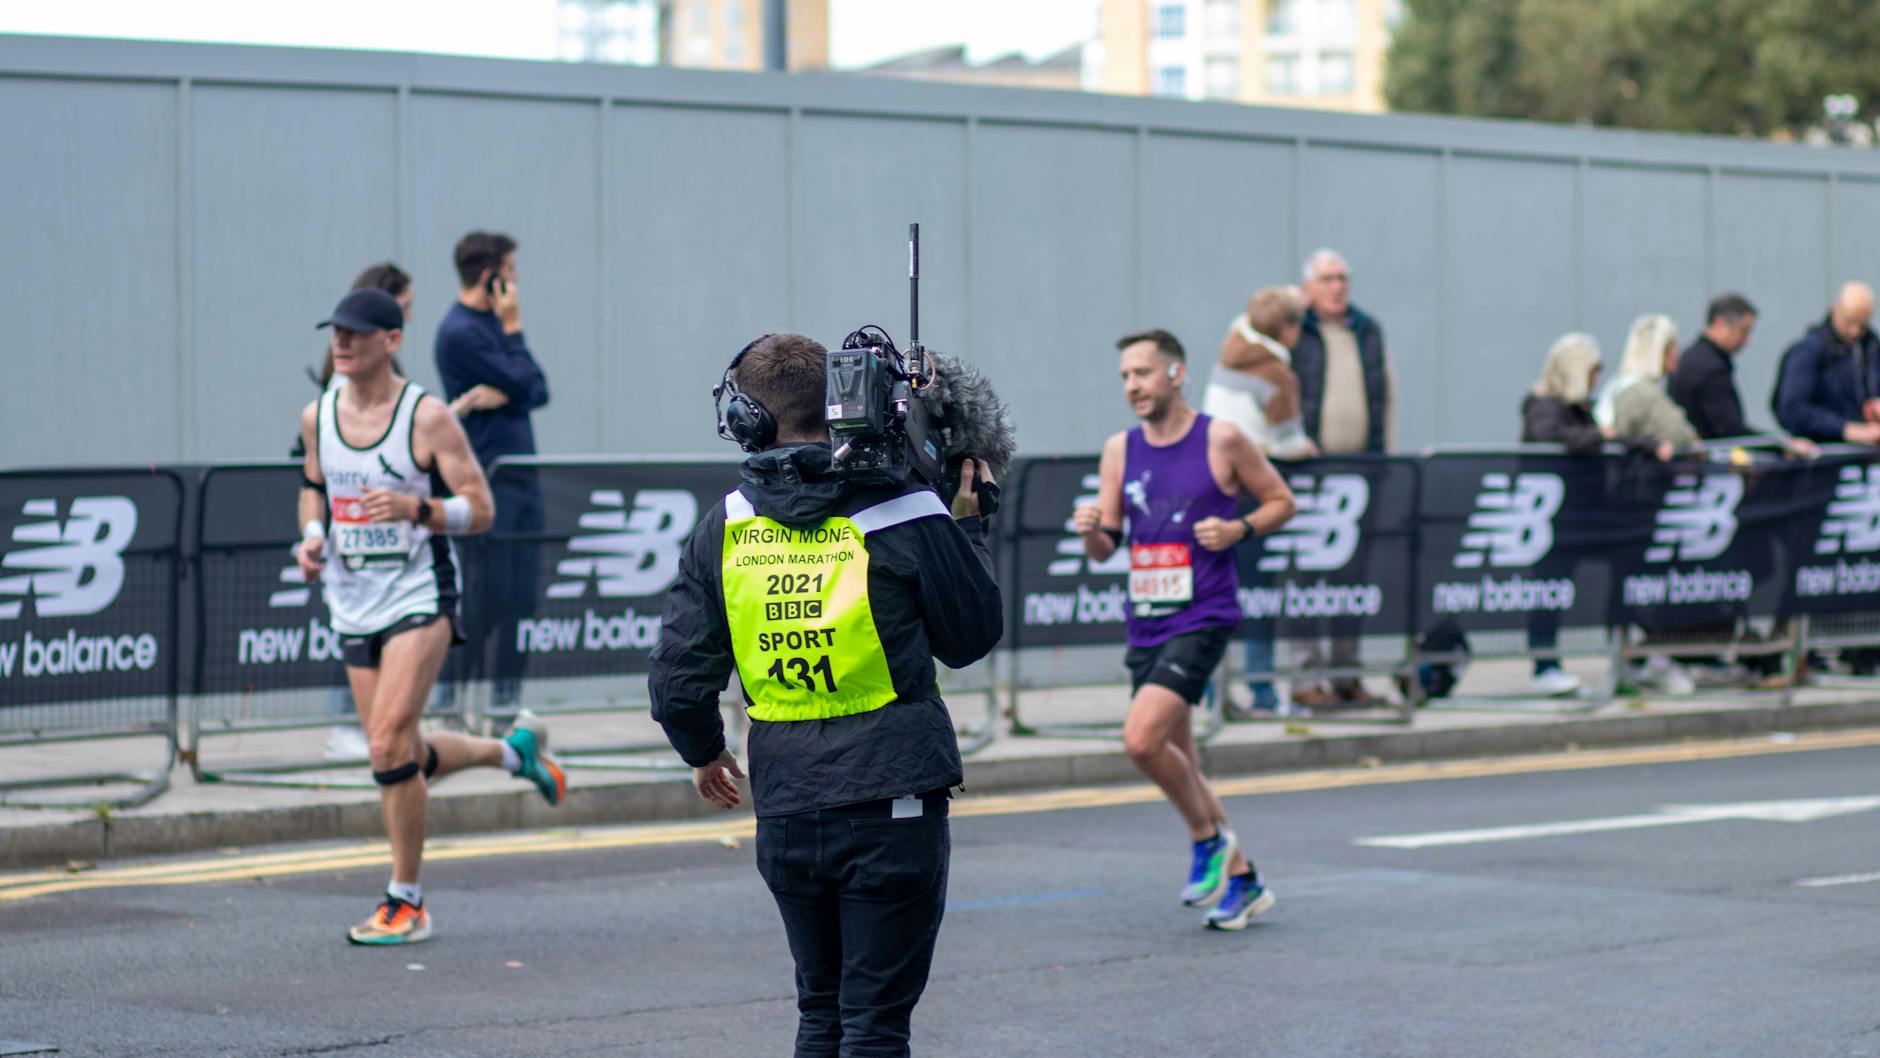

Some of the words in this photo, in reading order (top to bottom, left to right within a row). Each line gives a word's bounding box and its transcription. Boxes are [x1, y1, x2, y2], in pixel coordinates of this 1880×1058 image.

[342, 528, 398, 549] 27385
[732, 528, 792, 545] VIRGIN
[799, 526, 858, 544] MONE
[736, 554, 784, 566] LONDON
[788, 550, 854, 565] MARATHON
[767, 573, 823, 595] 2021
[1285, 579, 1381, 616] balance
[1434, 583, 1479, 612] new
[1482, 573, 1575, 612] balance
[1668, 567, 1752, 603] balance
[766, 600, 822, 620] BBC
[1024, 593, 1075, 624] new
[239, 626, 304, 663] new
[517, 617, 581, 652] new
[758, 628, 836, 651] SPORT
[23, 628, 157, 676] balance
[768, 655, 838, 693] 131
